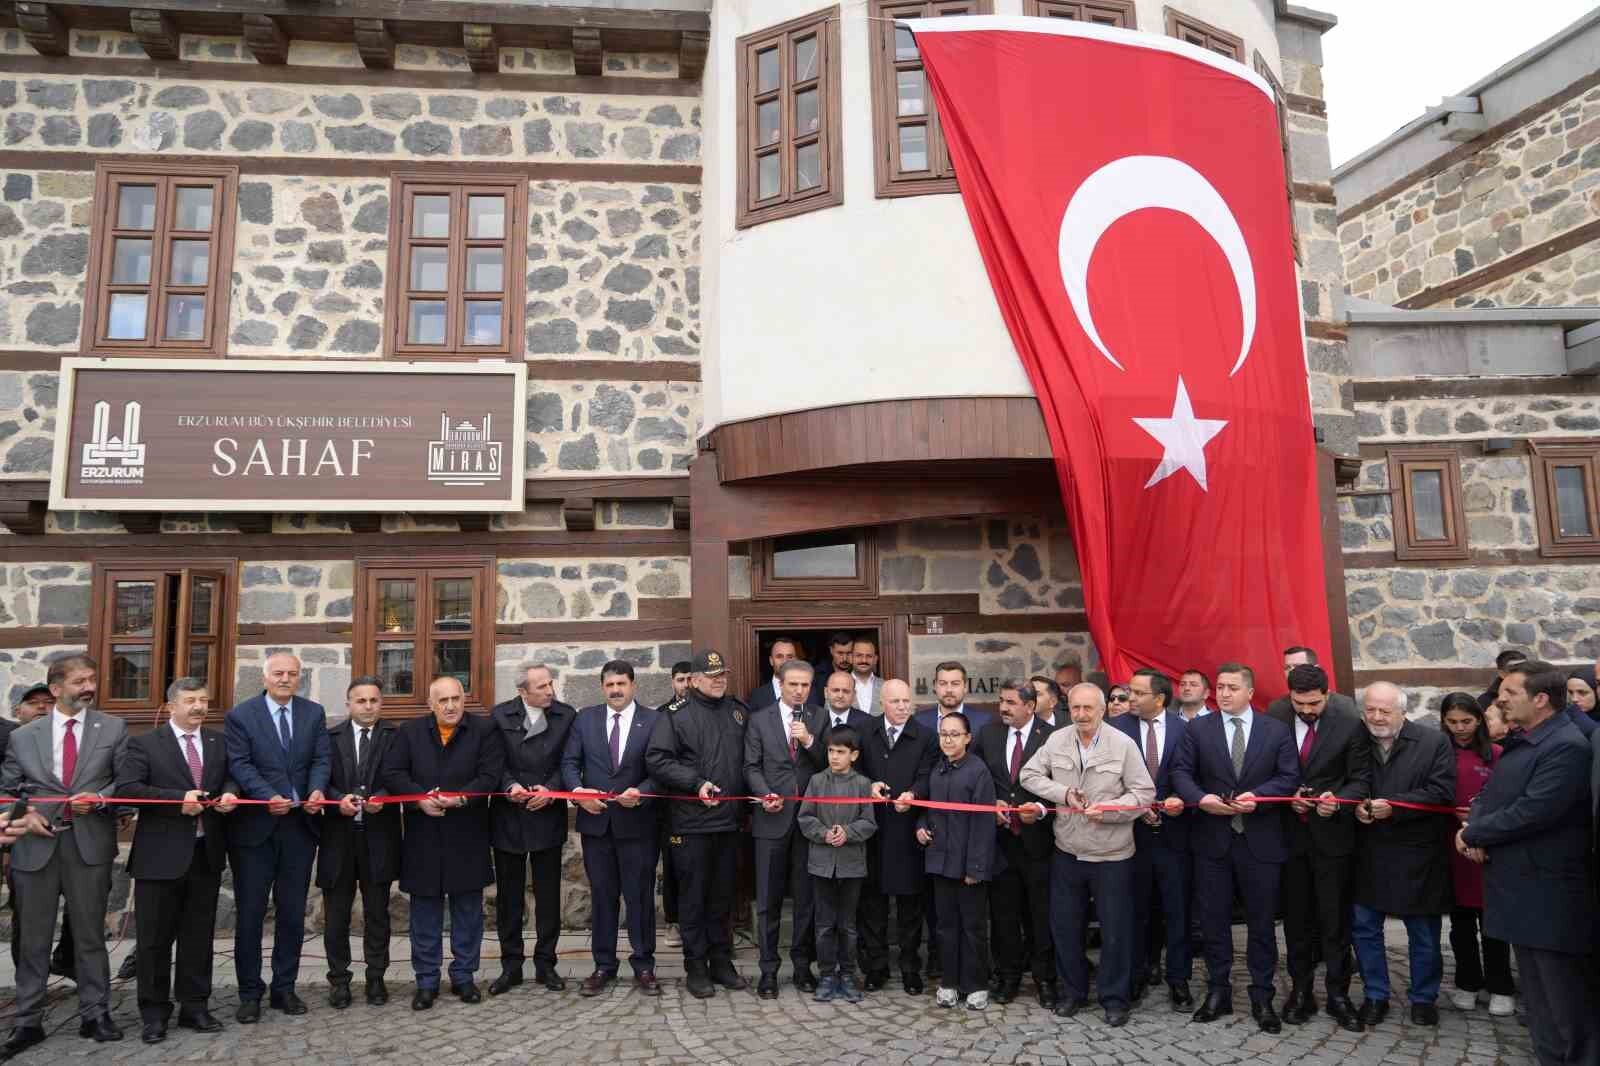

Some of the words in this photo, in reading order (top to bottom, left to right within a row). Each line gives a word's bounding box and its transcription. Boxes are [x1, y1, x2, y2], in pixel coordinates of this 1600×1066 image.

[178, 415, 244, 426] ERZURUM
[212, 437, 375, 476] SAHAF
[81, 466, 145, 478] ERZURUM
